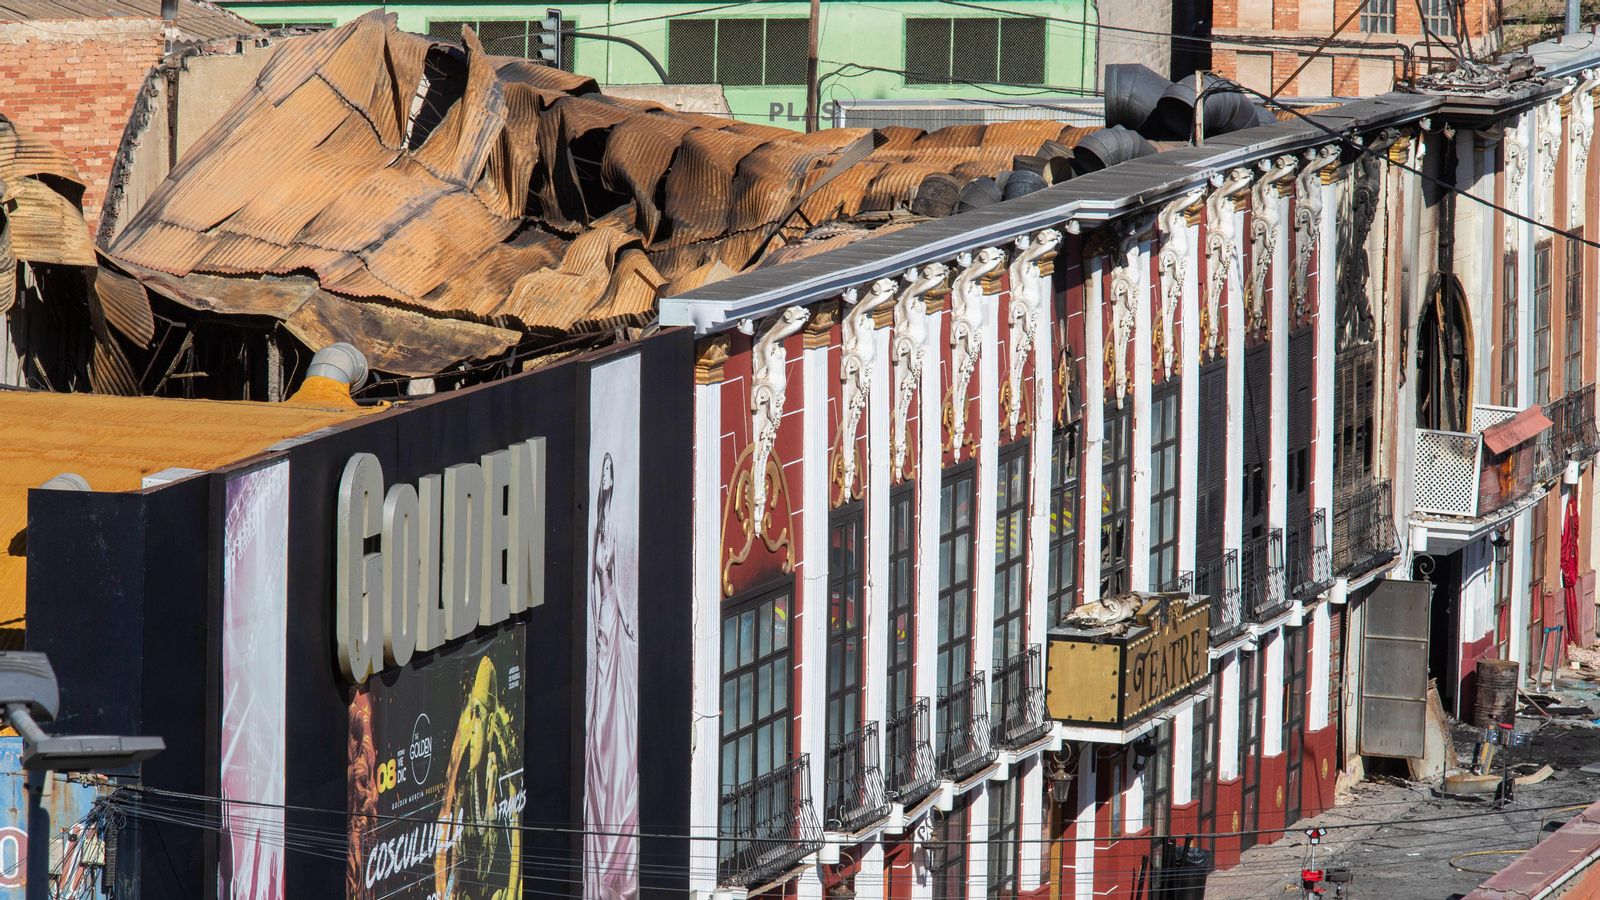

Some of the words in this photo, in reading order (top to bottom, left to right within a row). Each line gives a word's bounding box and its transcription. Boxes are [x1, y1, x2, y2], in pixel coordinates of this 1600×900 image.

[337, 436, 546, 684] GOLDEN
[1133, 630, 1201, 707] TEATRE
[409, 736, 432, 760] GOLDEN
[376, 758, 397, 794] 08
[397, 767, 407, 783] DIC
